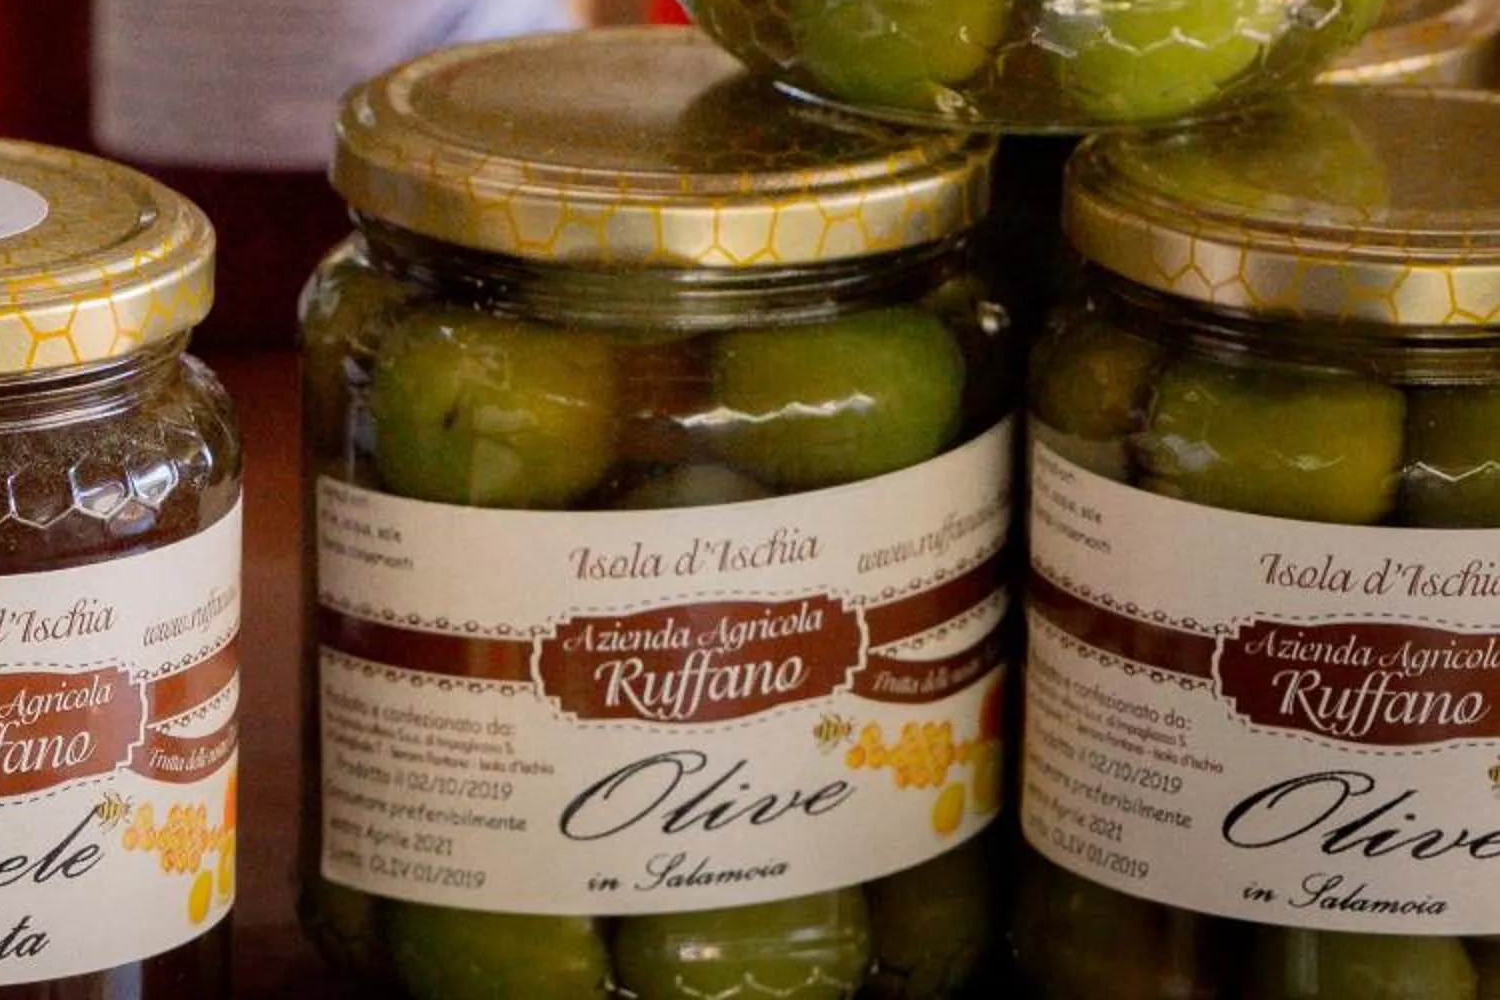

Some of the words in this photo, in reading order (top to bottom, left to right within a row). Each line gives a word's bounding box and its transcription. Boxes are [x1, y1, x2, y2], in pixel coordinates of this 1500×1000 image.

[568, 541, 664, 579] Isola
[675, 528, 821, 577] d'Ischia
[1260, 552, 1357, 595] Isola
[563, 616, 690, 653] Azienda
[699, 602, 823, 656] Agricola
[1245, 629, 1374, 667] Azienda
[594, 649, 808, 720] Ruffano
[1272, 669, 1491, 736] Ruffano
[559, 749, 856, 841] Olive
[587, 872, 620, 892] in
[634, 852, 790, 892] Salamoia
[1243, 881, 1276, 902] in
[1290, 872, 1448, 916] Salamoia
